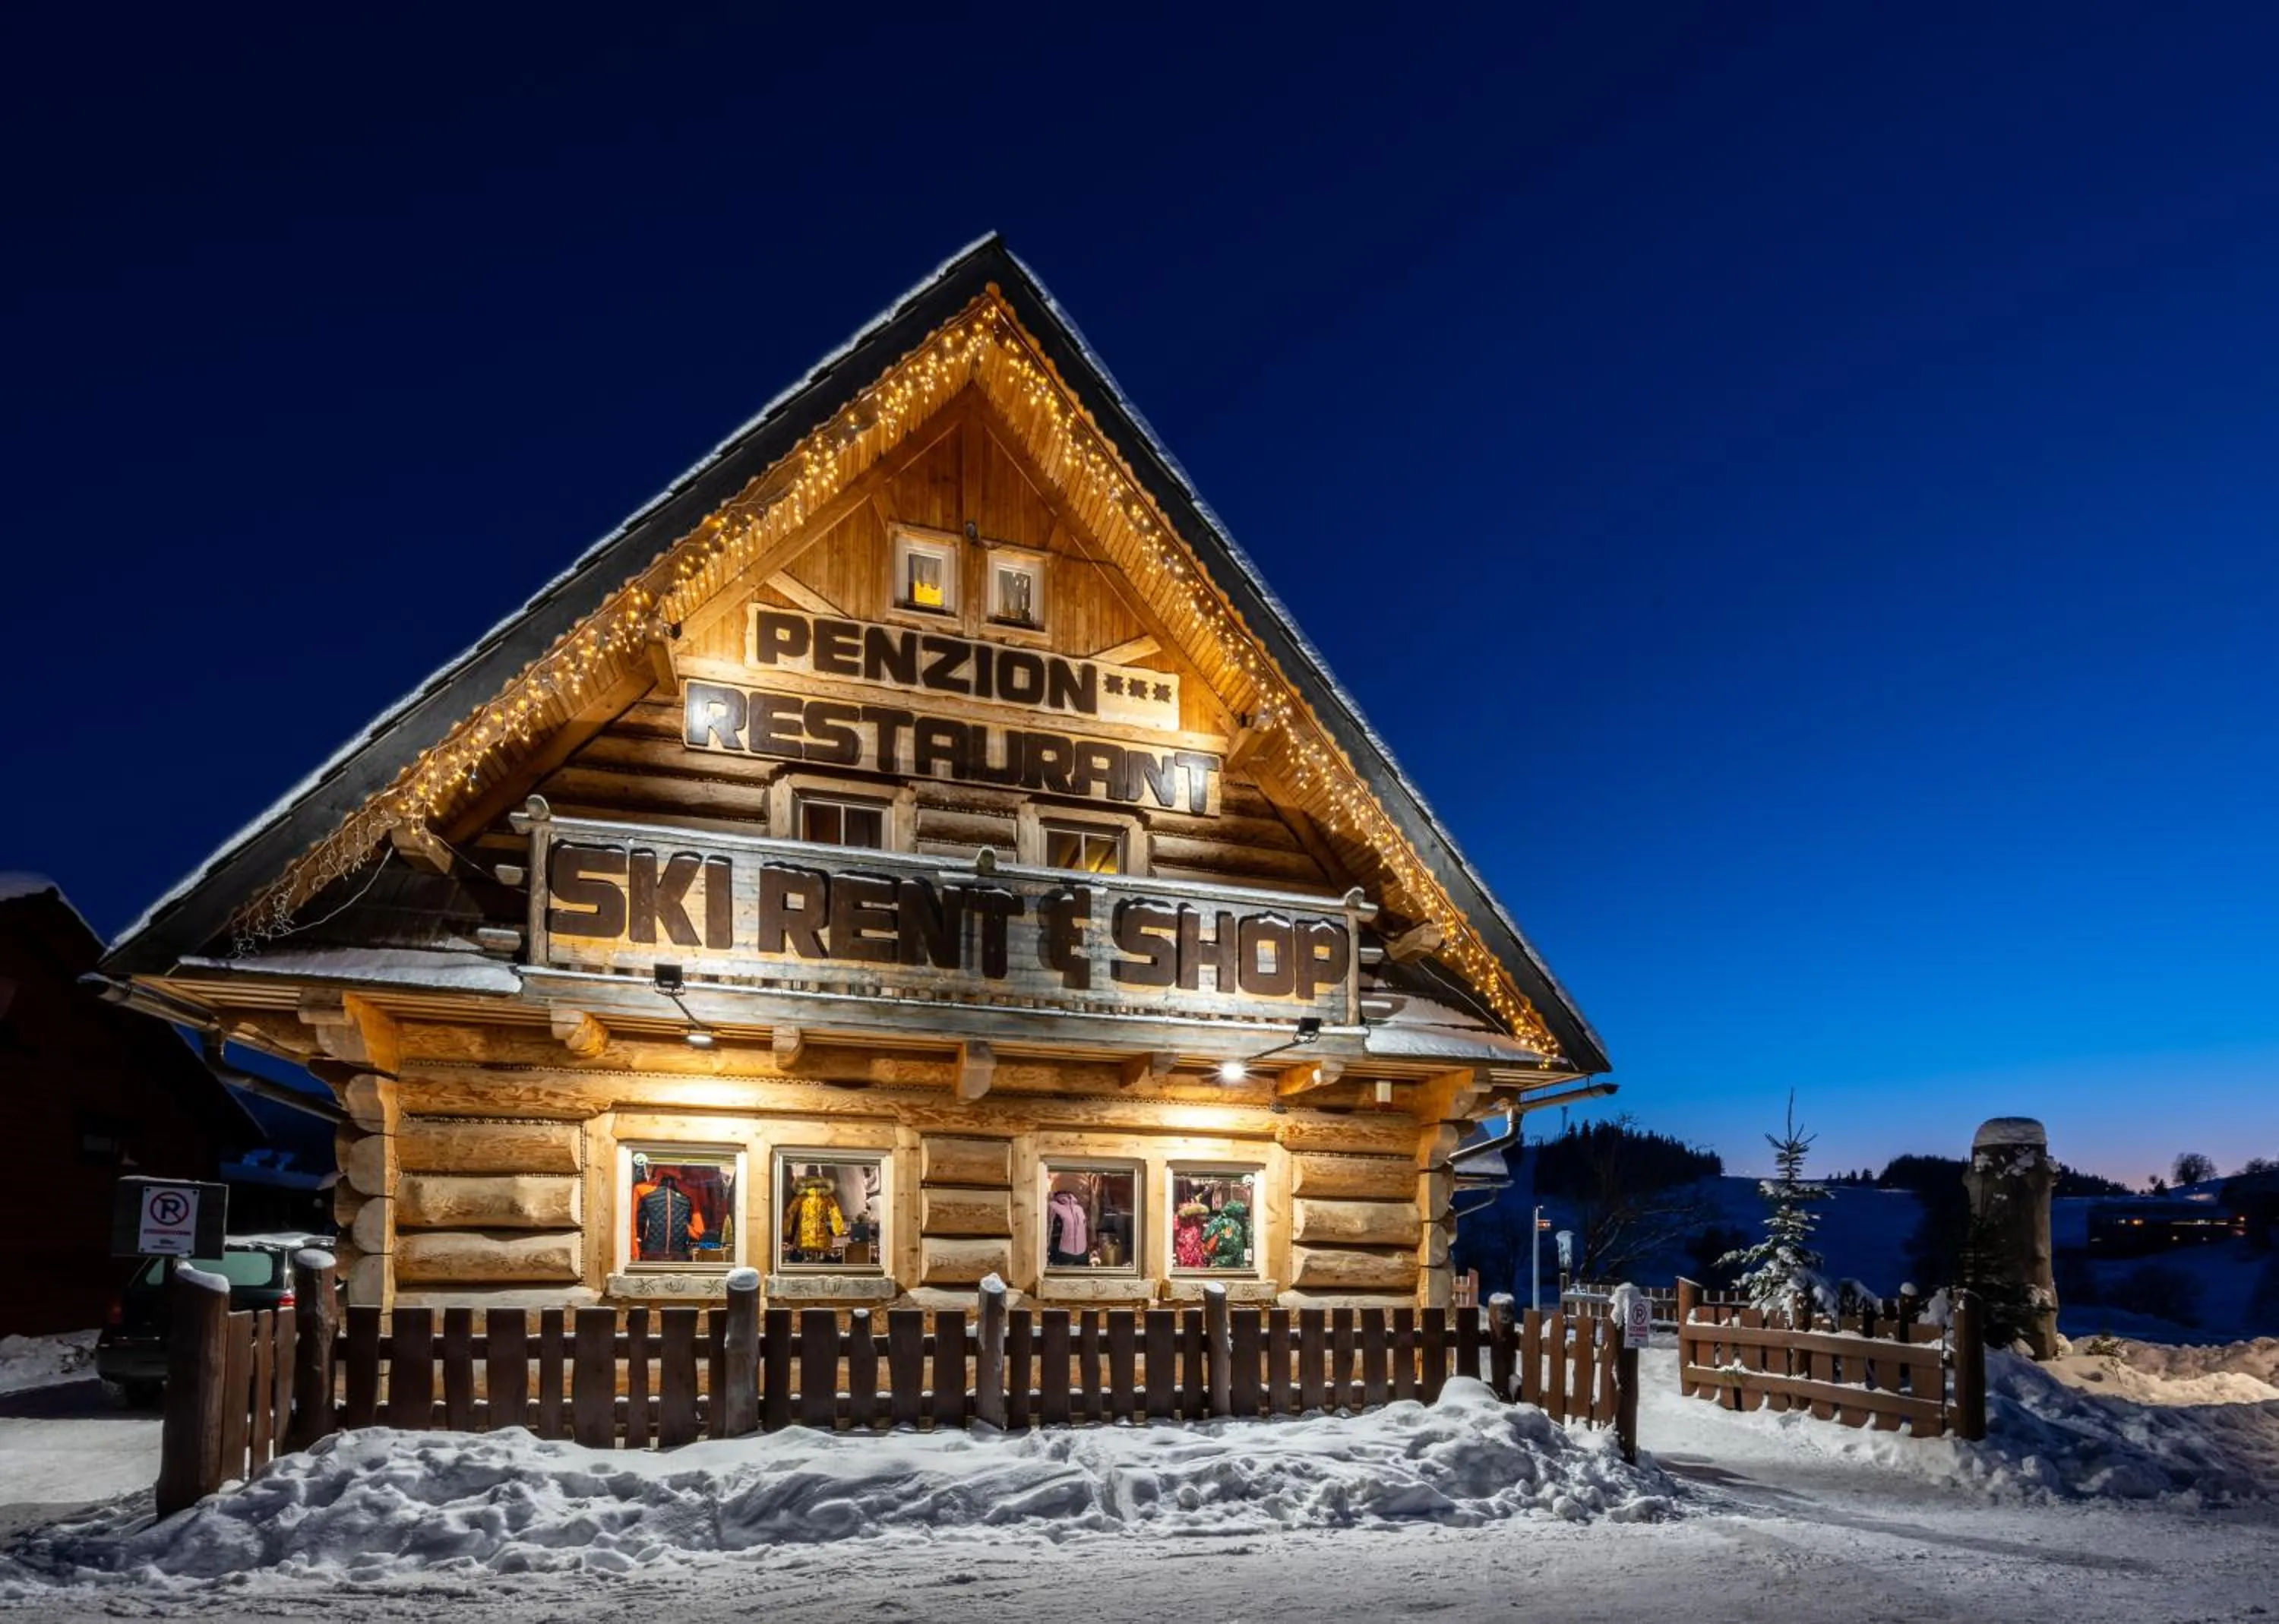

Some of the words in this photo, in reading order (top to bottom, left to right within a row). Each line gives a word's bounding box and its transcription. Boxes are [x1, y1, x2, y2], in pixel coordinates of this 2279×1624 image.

[755, 609, 1098, 715] PENZION
[685, 683, 1220, 815] RESTAURANT
[545, 839, 733, 949] SKI
[758, 861, 1024, 979] RENT
[1111, 897, 1349, 1000] SHOP
